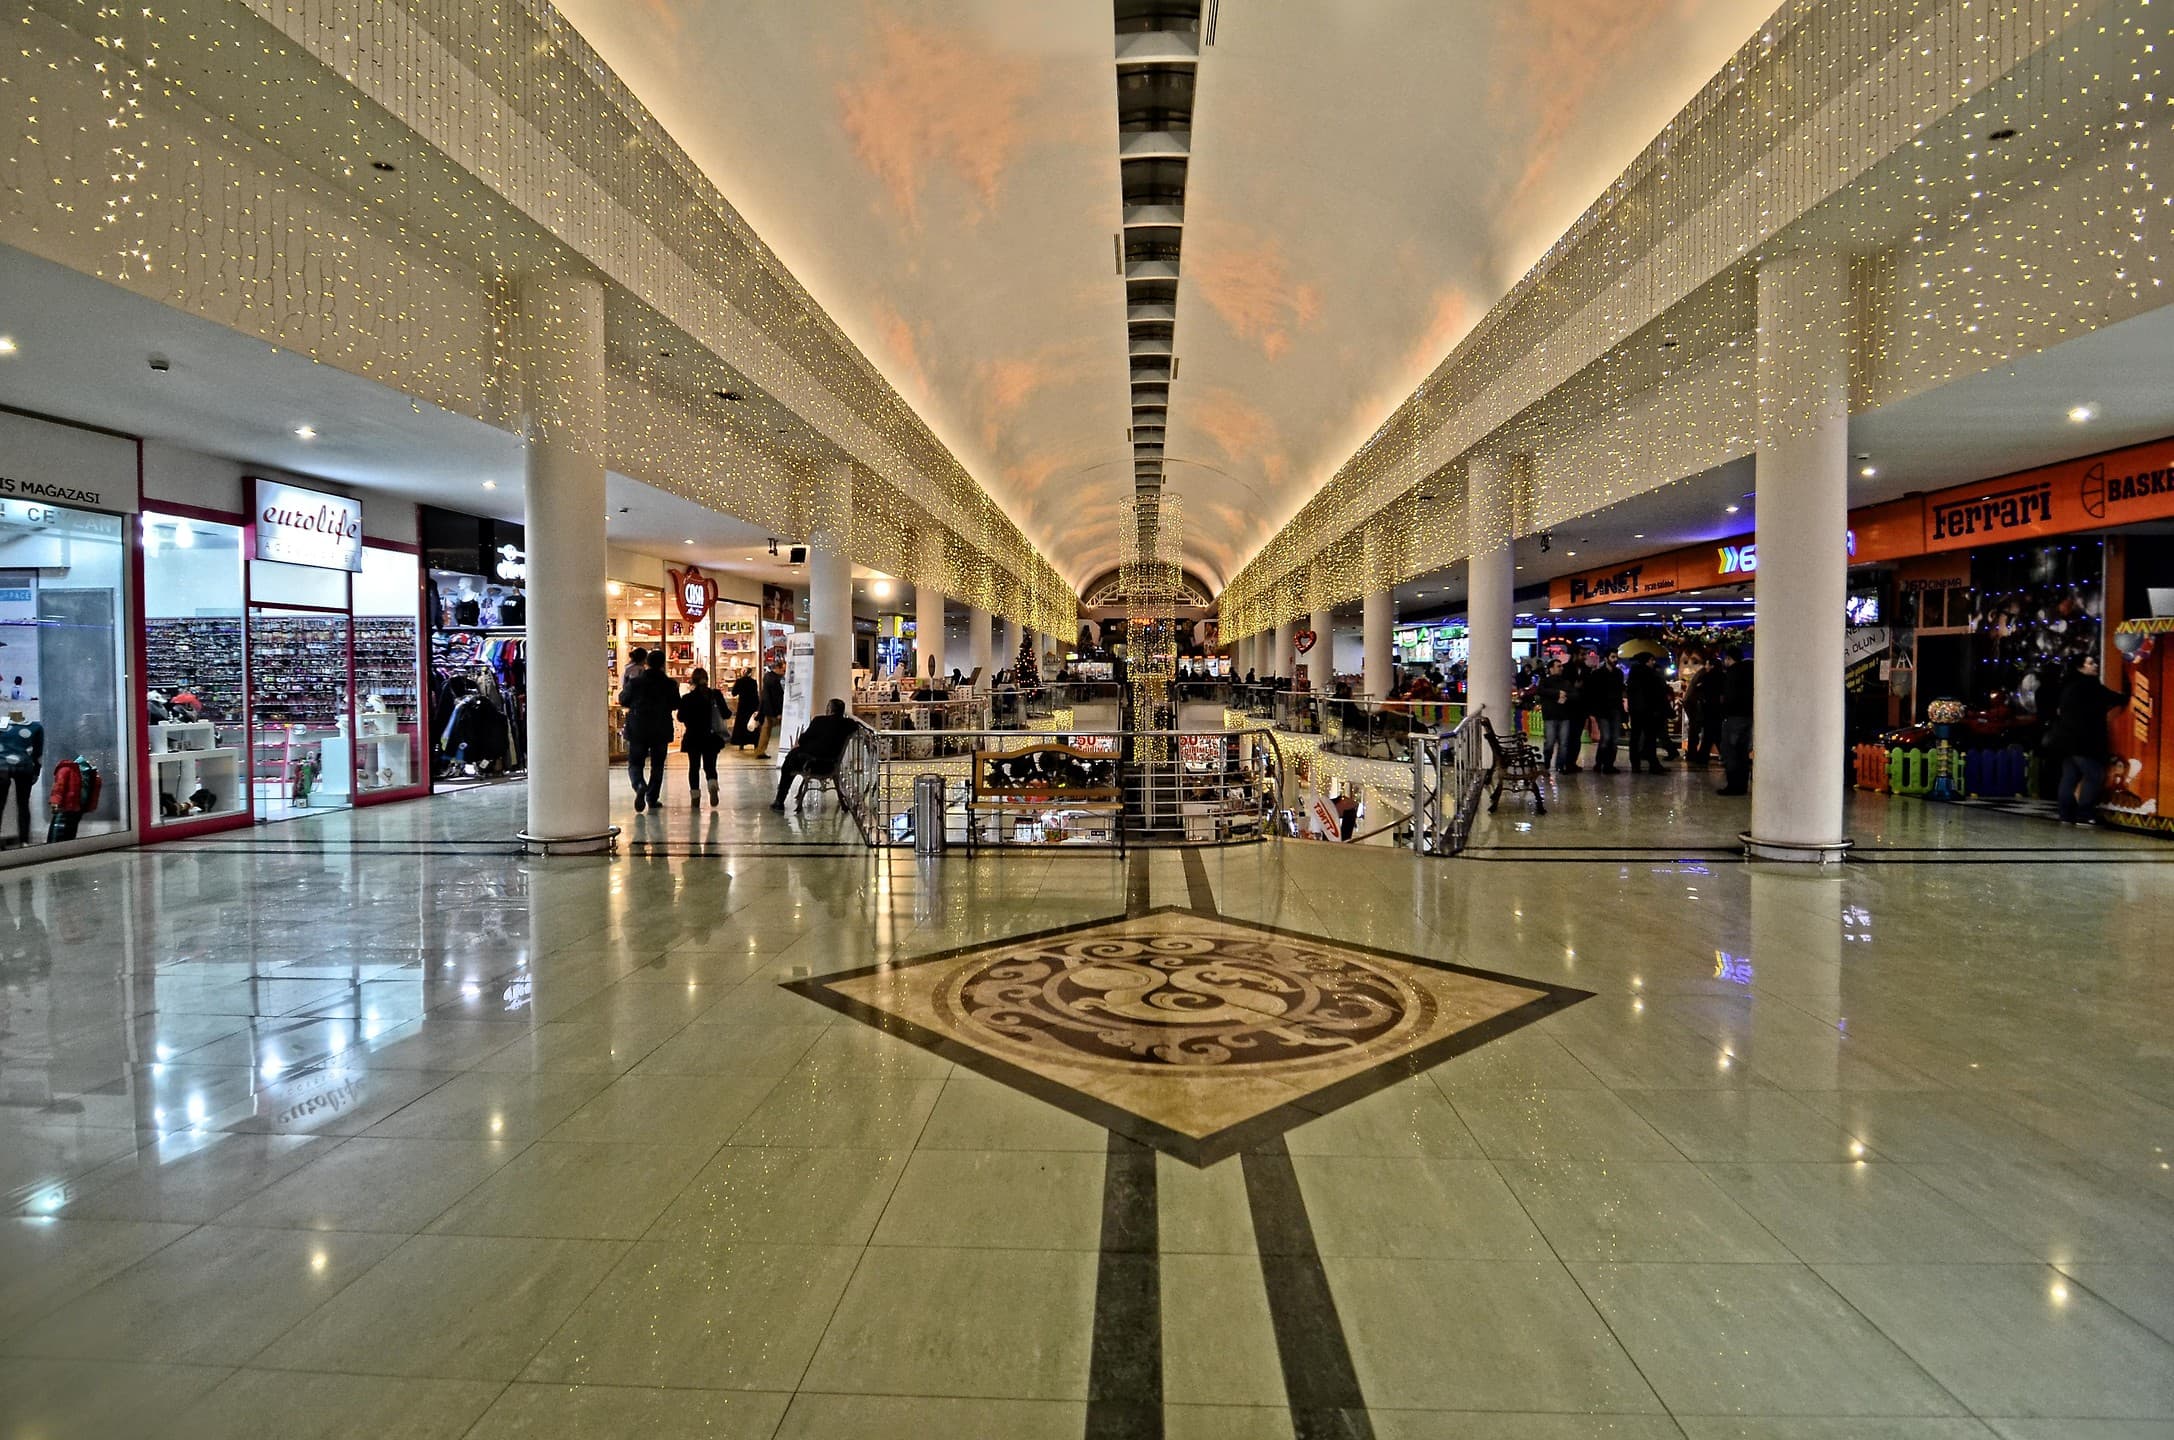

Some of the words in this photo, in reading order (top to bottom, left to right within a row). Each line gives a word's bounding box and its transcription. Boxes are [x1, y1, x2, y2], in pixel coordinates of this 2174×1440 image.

[21, 481, 101, 504] MAĞAZASI
[1933, 482, 2052, 540] Ferrari
[263, 505, 358, 545] eurolife
[1570, 565, 1643, 603] PLANET
